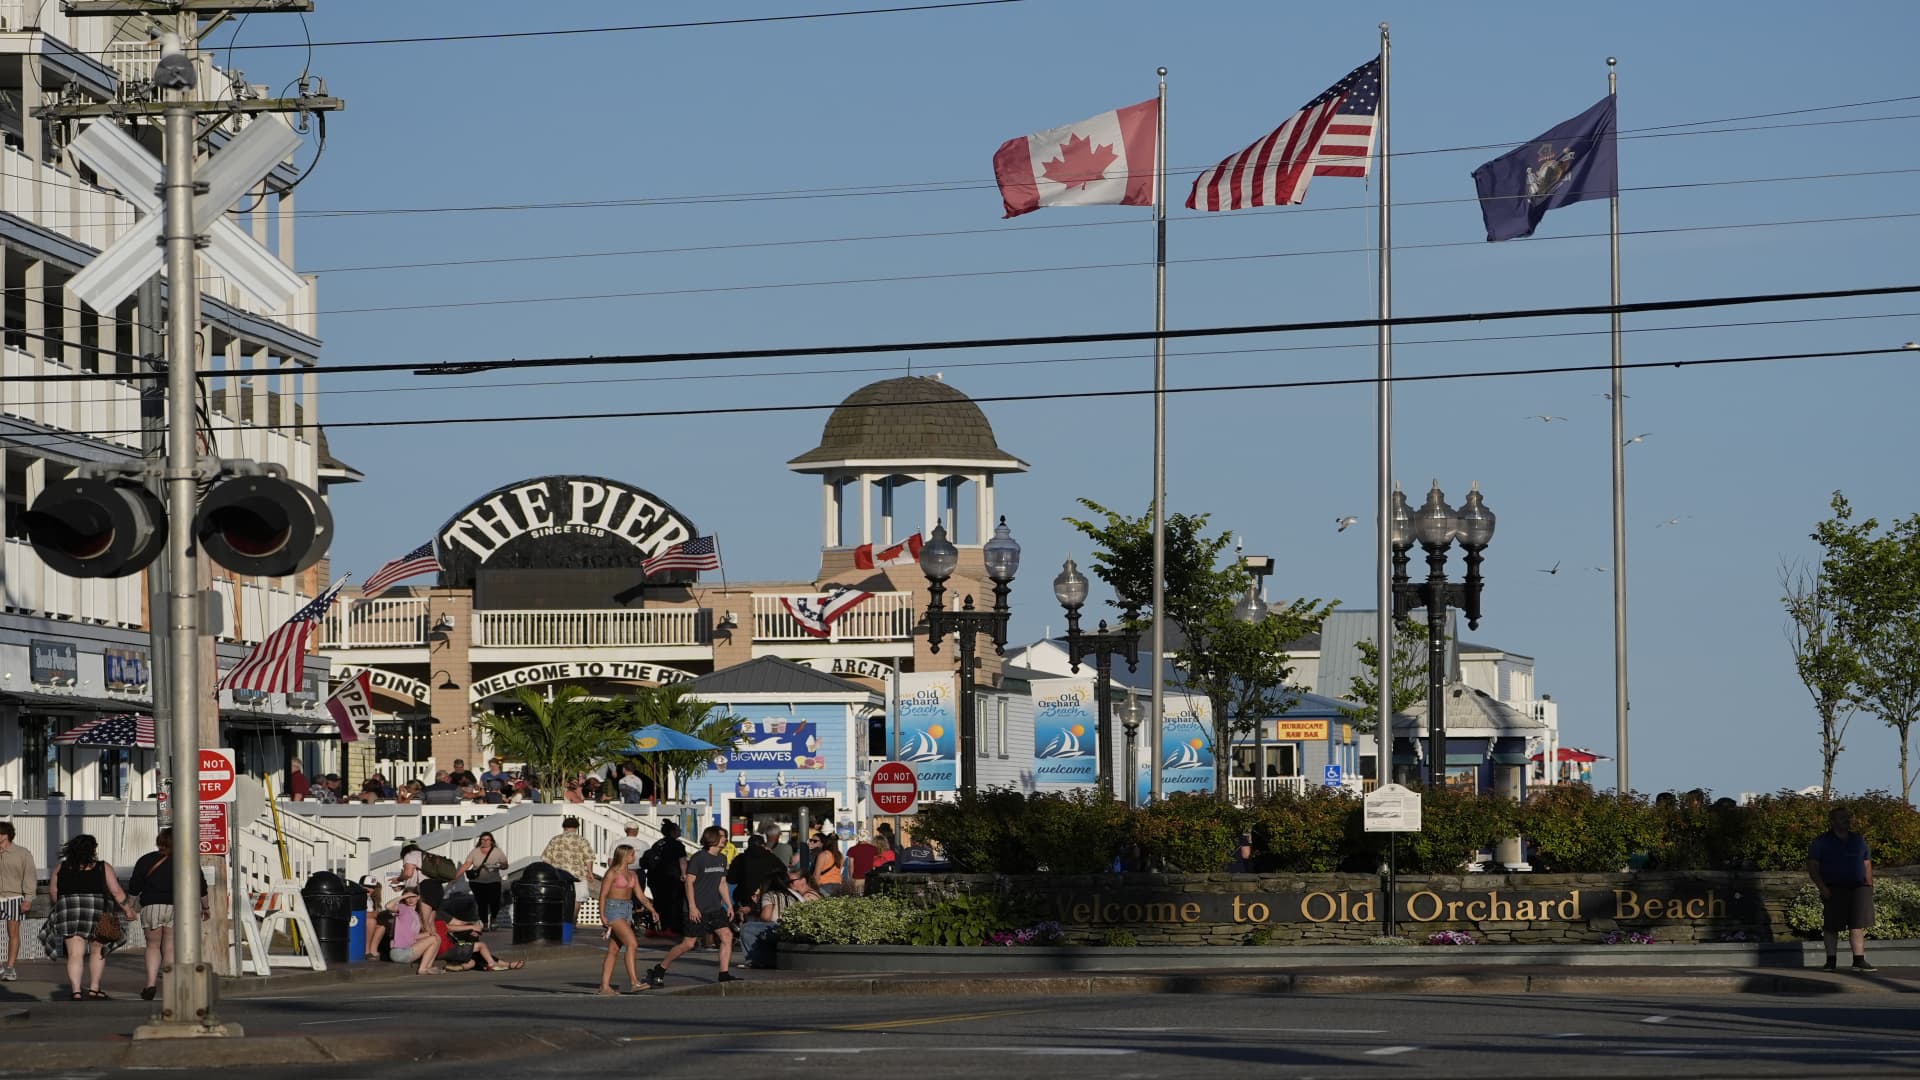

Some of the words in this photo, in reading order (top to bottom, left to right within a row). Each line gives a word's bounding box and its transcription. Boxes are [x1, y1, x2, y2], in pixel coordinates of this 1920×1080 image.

[443, 482, 554, 564] THE
[567, 481, 690, 558] PIER
[531, 525, 572, 538] SINCE
[576, 525, 605, 538] 1898
[330, 667, 428, 701] ADING
[473, 664, 570, 697] WELCOME
[576, 663, 604, 676] TO
[610, 663, 652, 679] THE
[917, 690, 938, 699] Old
[1060, 693, 1078, 701] Old
[892, 697, 940, 706] rchard
[1038, 700, 1080, 708] Orchard
[901, 704, 944, 717] Beach
[203, 760, 225, 768] NOT
[1037, 763, 1092, 774] welcome
[877, 772, 889, 781] DO
[893, 772, 911, 781] NOT
[917, 772, 952, 781] come
[1161, 774, 1210, 784] welcome
[199, 783, 221, 791] TER
[753, 788, 775, 798] ICE
[779, 788, 827, 798] CREAM
[880, 795, 908, 804] ENTER
[1231, 895, 1270, 923] to
[1300, 892, 1376, 923] Old
[1406, 890, 1582, 922] Orchard
[1612, 889, 1728, 920] Beach
